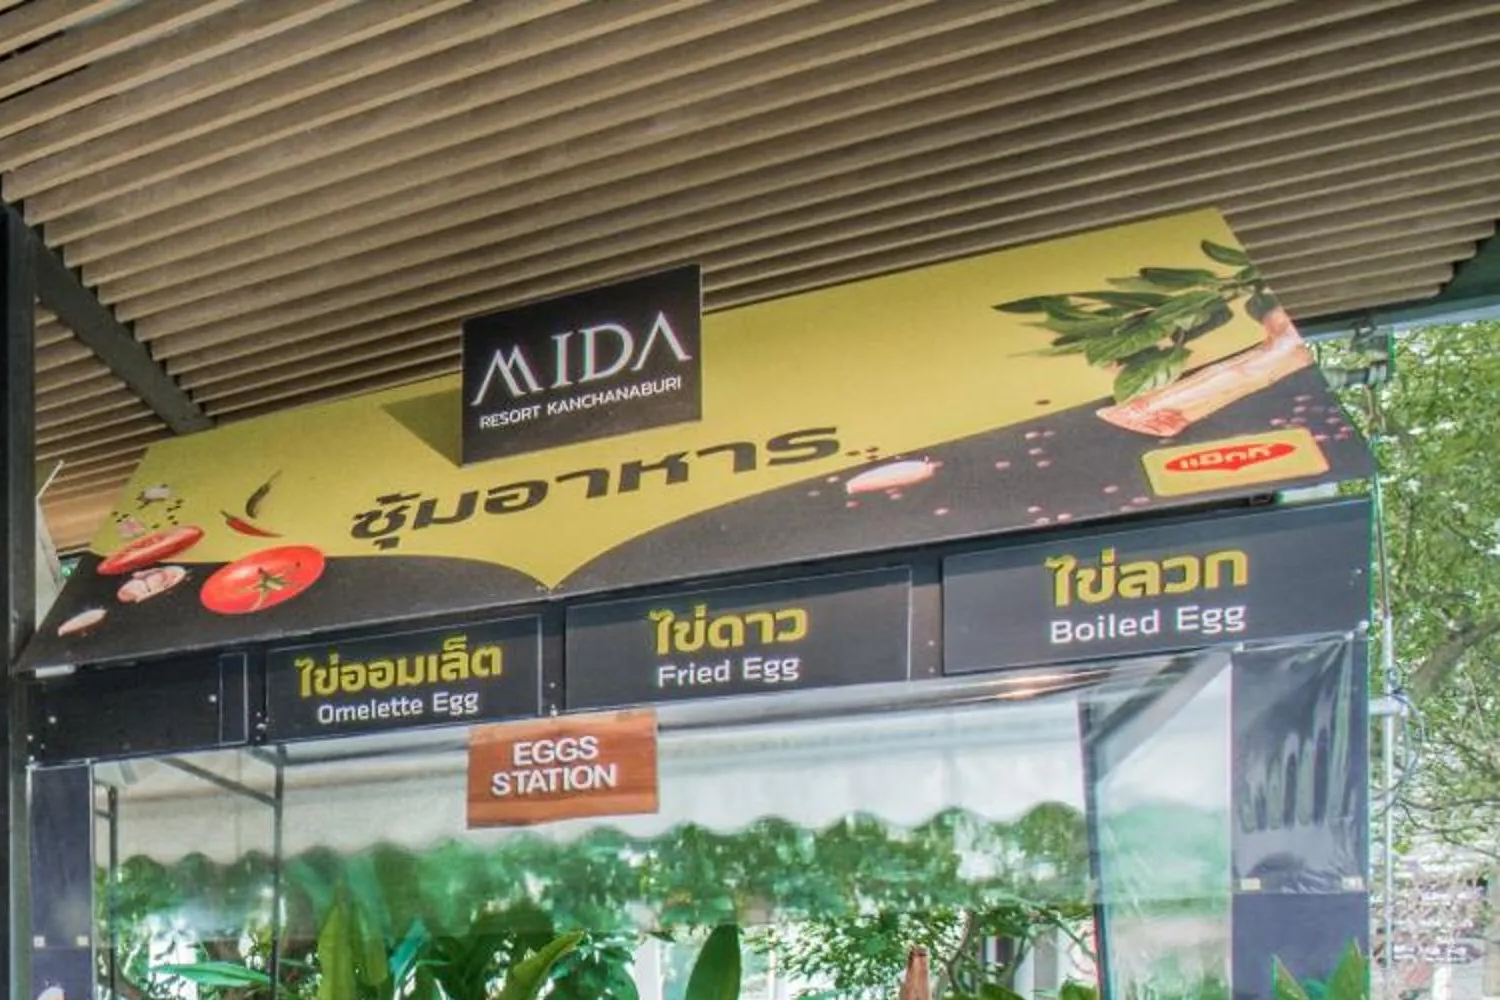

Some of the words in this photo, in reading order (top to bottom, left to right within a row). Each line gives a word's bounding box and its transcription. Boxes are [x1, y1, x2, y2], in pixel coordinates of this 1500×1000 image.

[471, 311, 692, 406] MIDA
[479, 405, 541, 430] RESORT
[547, 376, 682, 416] KANCHANABURI
[1045, 547, 1248, 608] ไข่ลวก
[646, 603, 809, 655] ไข่ดาว
[1051, 609, 1160, 643] Boiled
[1176, 605, 1246, 634] Egg
[294, 635, 503, 698] ไข่ออมเล็ต
[658, 659, 731, 688] Fried
[742, 656, 800, 683] Egg
[317, 698, 423, 724] Omelette
[433, 691, 480, 715] Egg
[513, 735, 599, 766] EGGS
[491, 763, 617, 796] STATION
